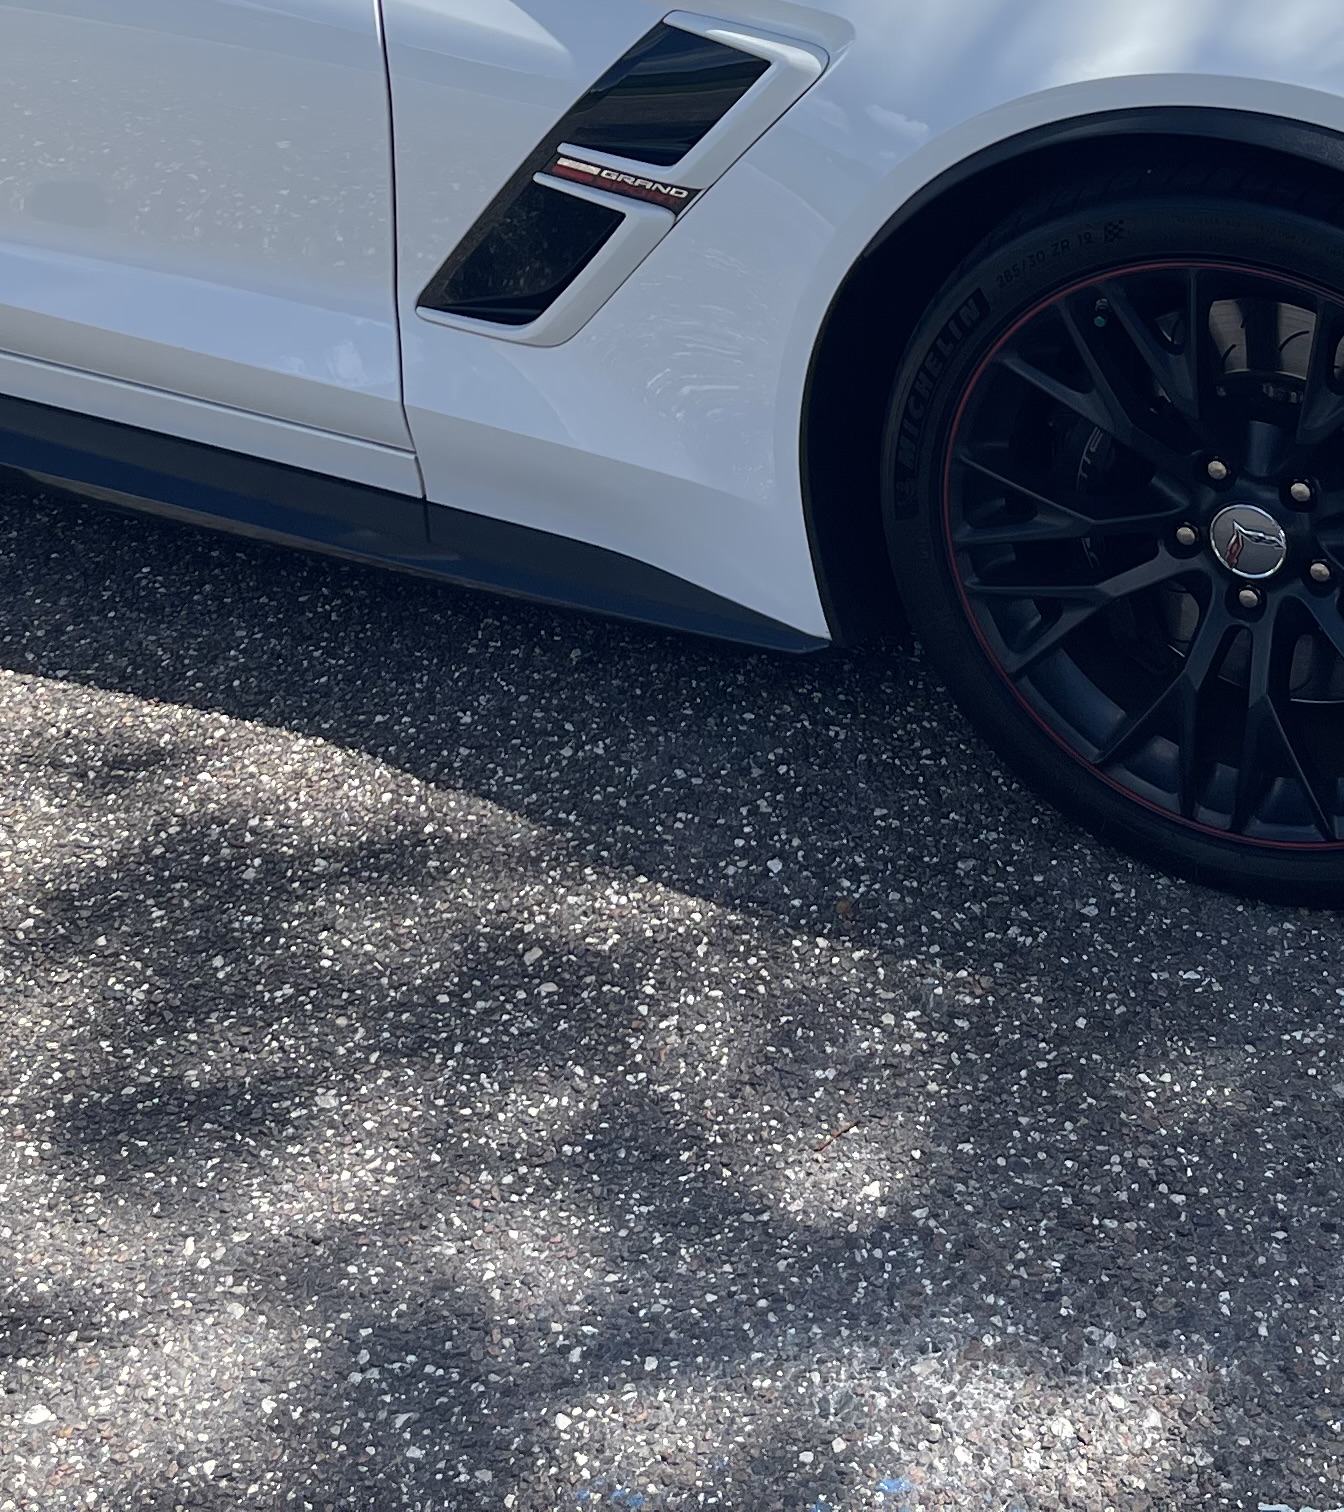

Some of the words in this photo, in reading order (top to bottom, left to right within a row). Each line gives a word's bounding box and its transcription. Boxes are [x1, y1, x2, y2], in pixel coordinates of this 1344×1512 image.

[600, 169, 689, 198] GRAND
[995, 249, 1046, 289] 285/30
[1050, 238, 1071, 257] ZR
[1077, 231, 1093, 246] 19
[896, 297, 981, 472] MICHELIN
